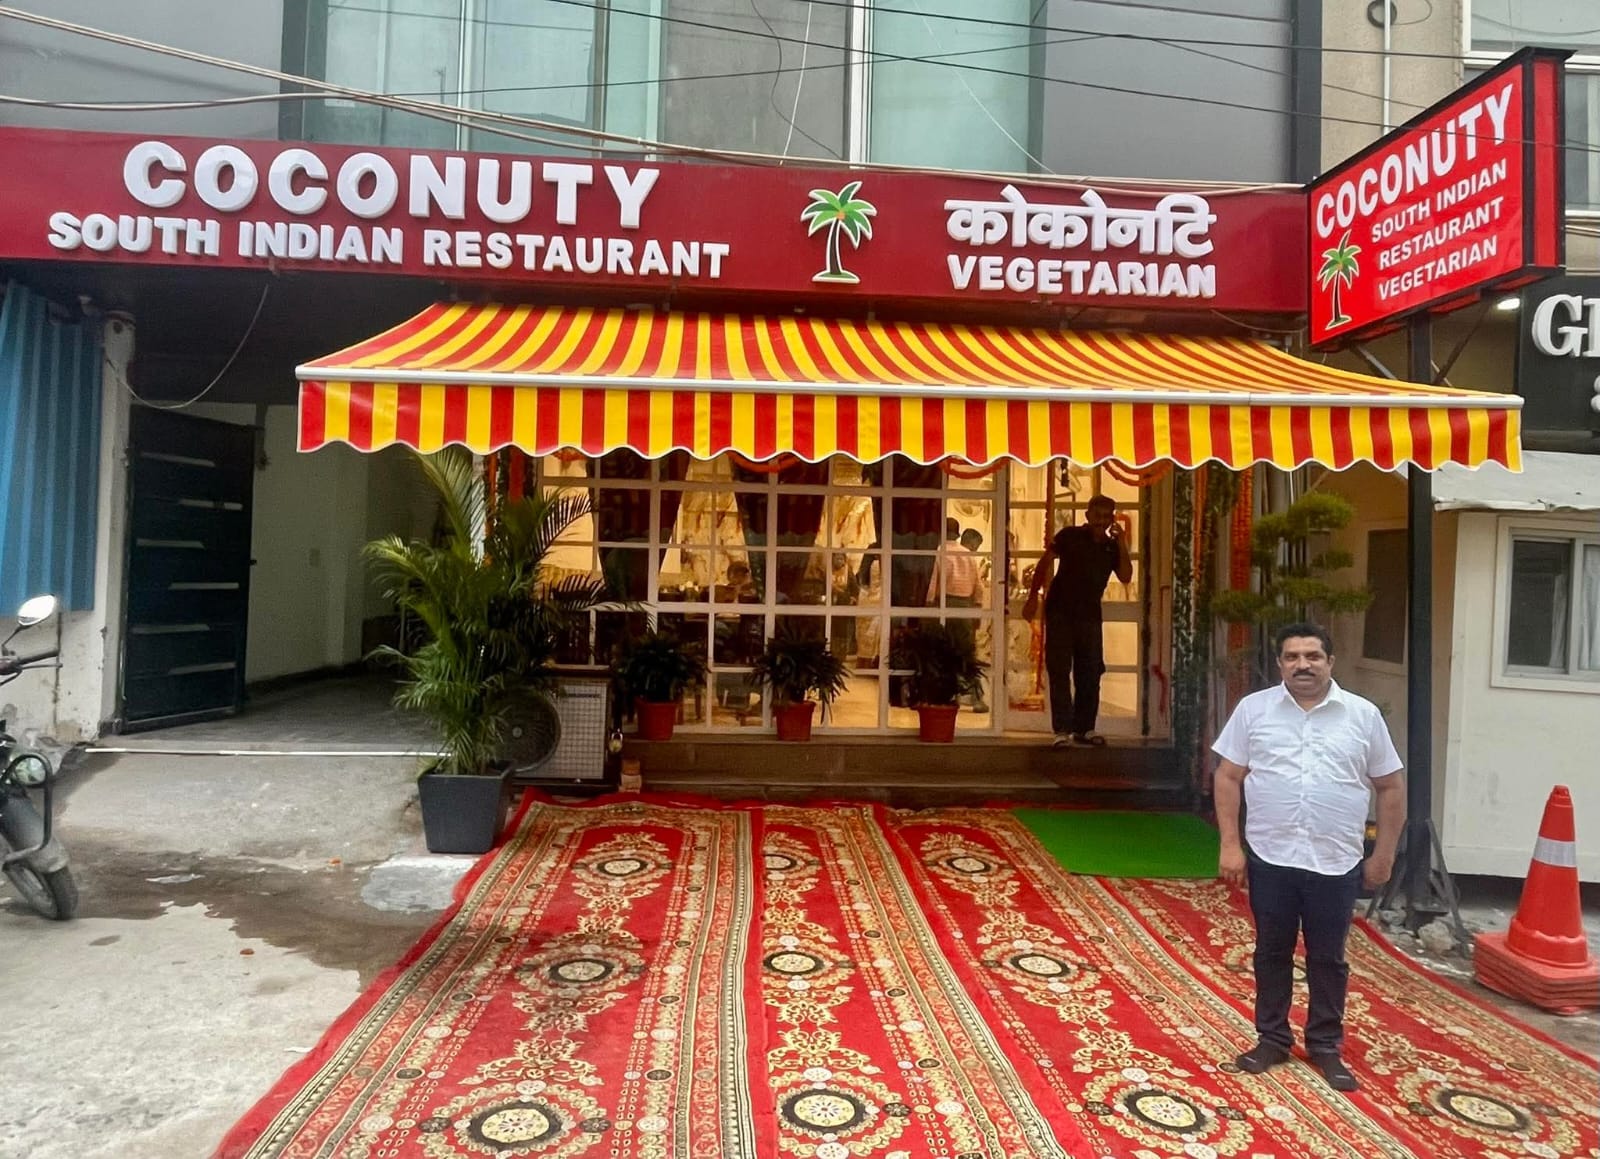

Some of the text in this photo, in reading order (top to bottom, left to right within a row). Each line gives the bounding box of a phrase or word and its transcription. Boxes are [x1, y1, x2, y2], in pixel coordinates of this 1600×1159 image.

[123, 141, 661, 230] COCONUTY
[1316, 83, 1513, 239] COCONUTY
[1371, 158, 1508, 244] SOUTH INDIAN
[1378, 196, 1505, 271] RESTAURANT
[47, 211, 730, 279] SOUTH INDIAN RESTAURANT
[947, 254, 1217, 299] VEGETARIAN
[1378, 235, 1498, 301] VEGETARIAN
